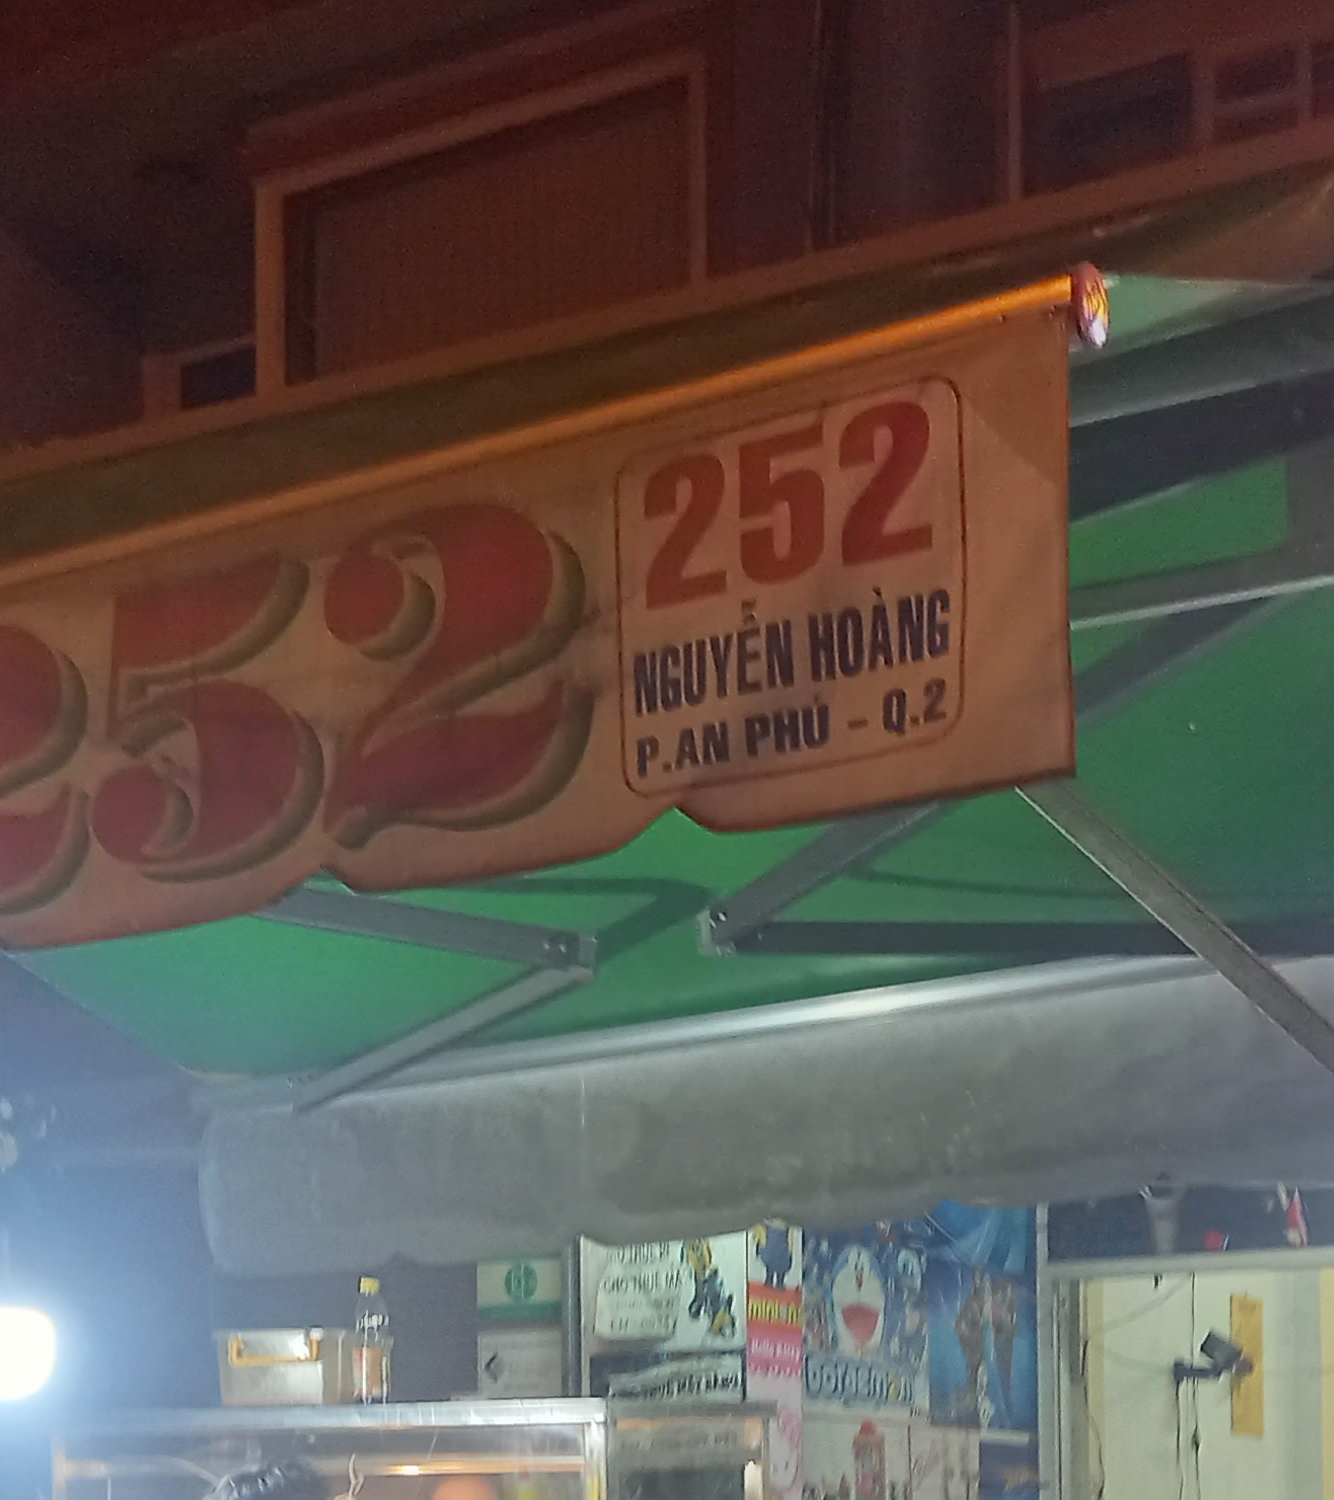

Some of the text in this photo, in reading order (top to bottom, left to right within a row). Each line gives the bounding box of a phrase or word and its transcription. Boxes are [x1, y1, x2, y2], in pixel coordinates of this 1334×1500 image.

[643, 401, 933, 611] 252
[633, 586, 951, 717] NGUYỄN HOÀNG
[637, 722, 730, 778] P.AN
[883, 678, 947, 735] Q.2
